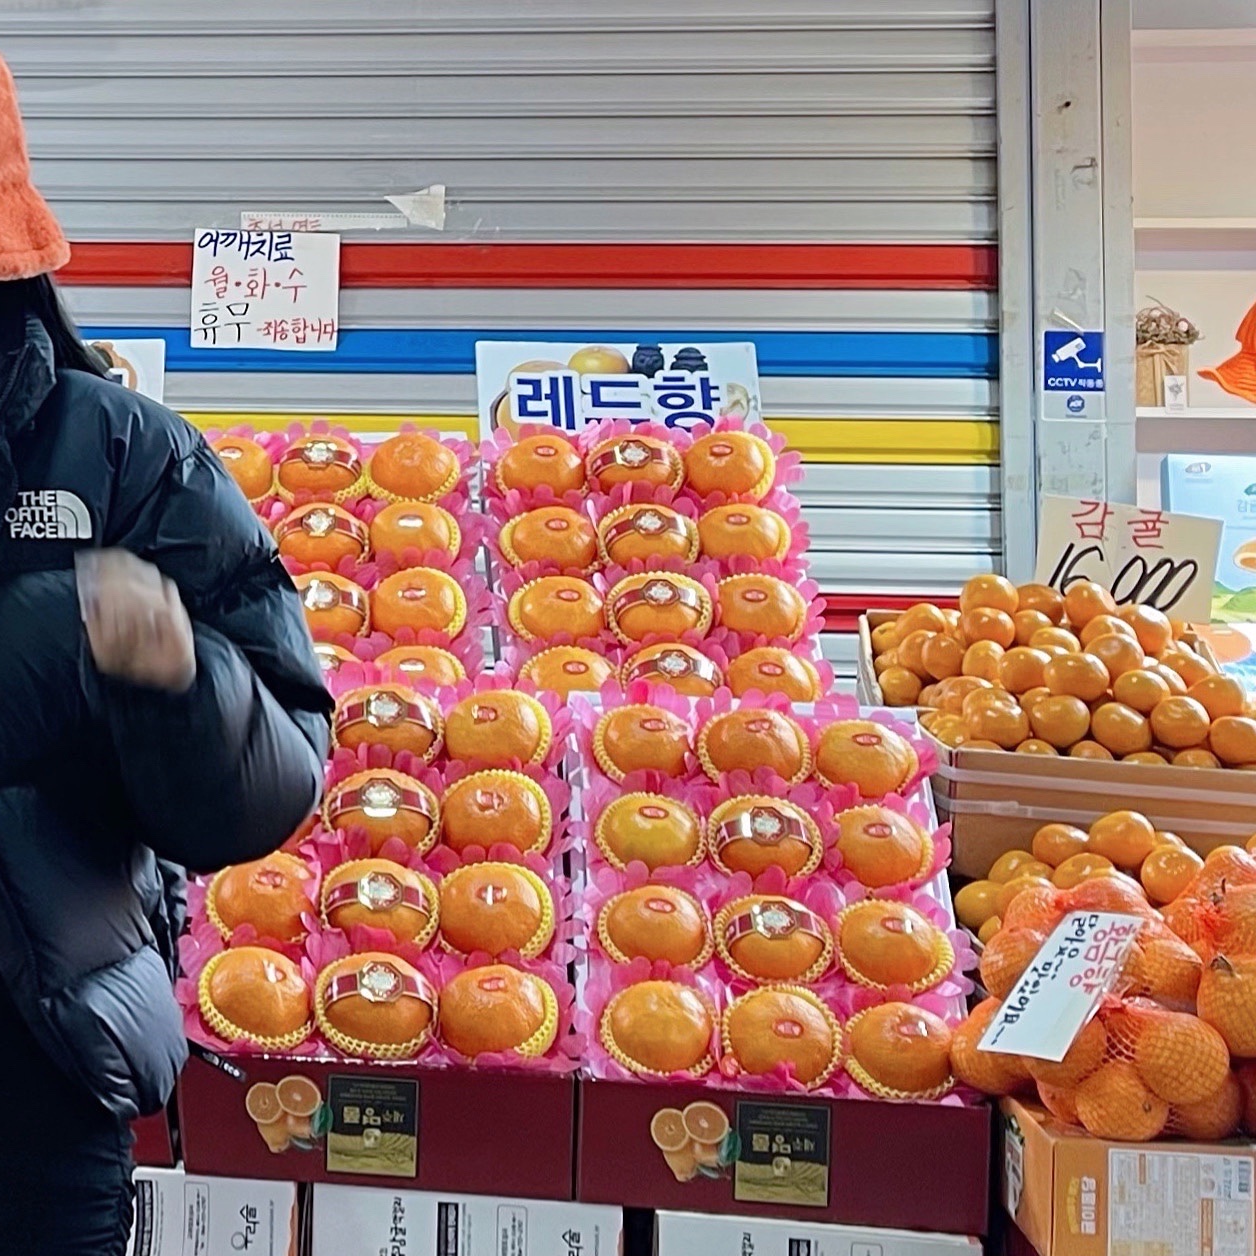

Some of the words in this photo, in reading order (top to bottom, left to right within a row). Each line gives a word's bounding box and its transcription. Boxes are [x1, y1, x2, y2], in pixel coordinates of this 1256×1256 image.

[197, 230, 295, 262] 어깨치료
[1047, 377, 1078, 388] CCTV
[516, 374, 721, 432] 레드향
[17, 489, 57, 506] THE
[4, 506, 57, 523] ORTH
[9, 522, 58, 539] FACE
